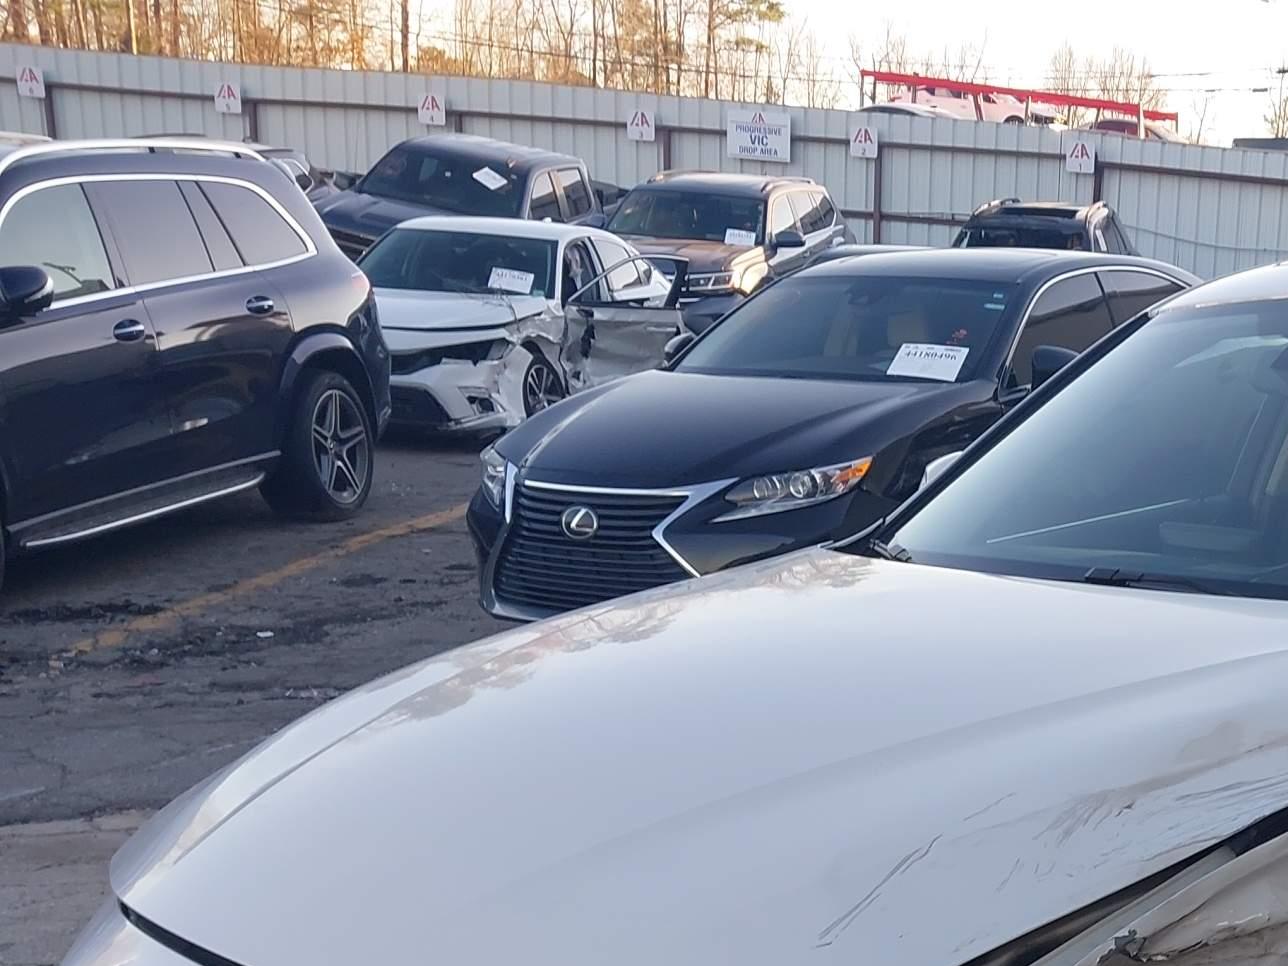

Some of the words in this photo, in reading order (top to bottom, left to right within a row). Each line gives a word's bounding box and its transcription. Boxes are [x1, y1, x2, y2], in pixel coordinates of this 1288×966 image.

[735, 124, 782, 136] PROGRESSIVE
[749, 135, 769, 146] VIC
[738, 145, 758, 154] DROP
[759, 147, 778, 157] AREA
